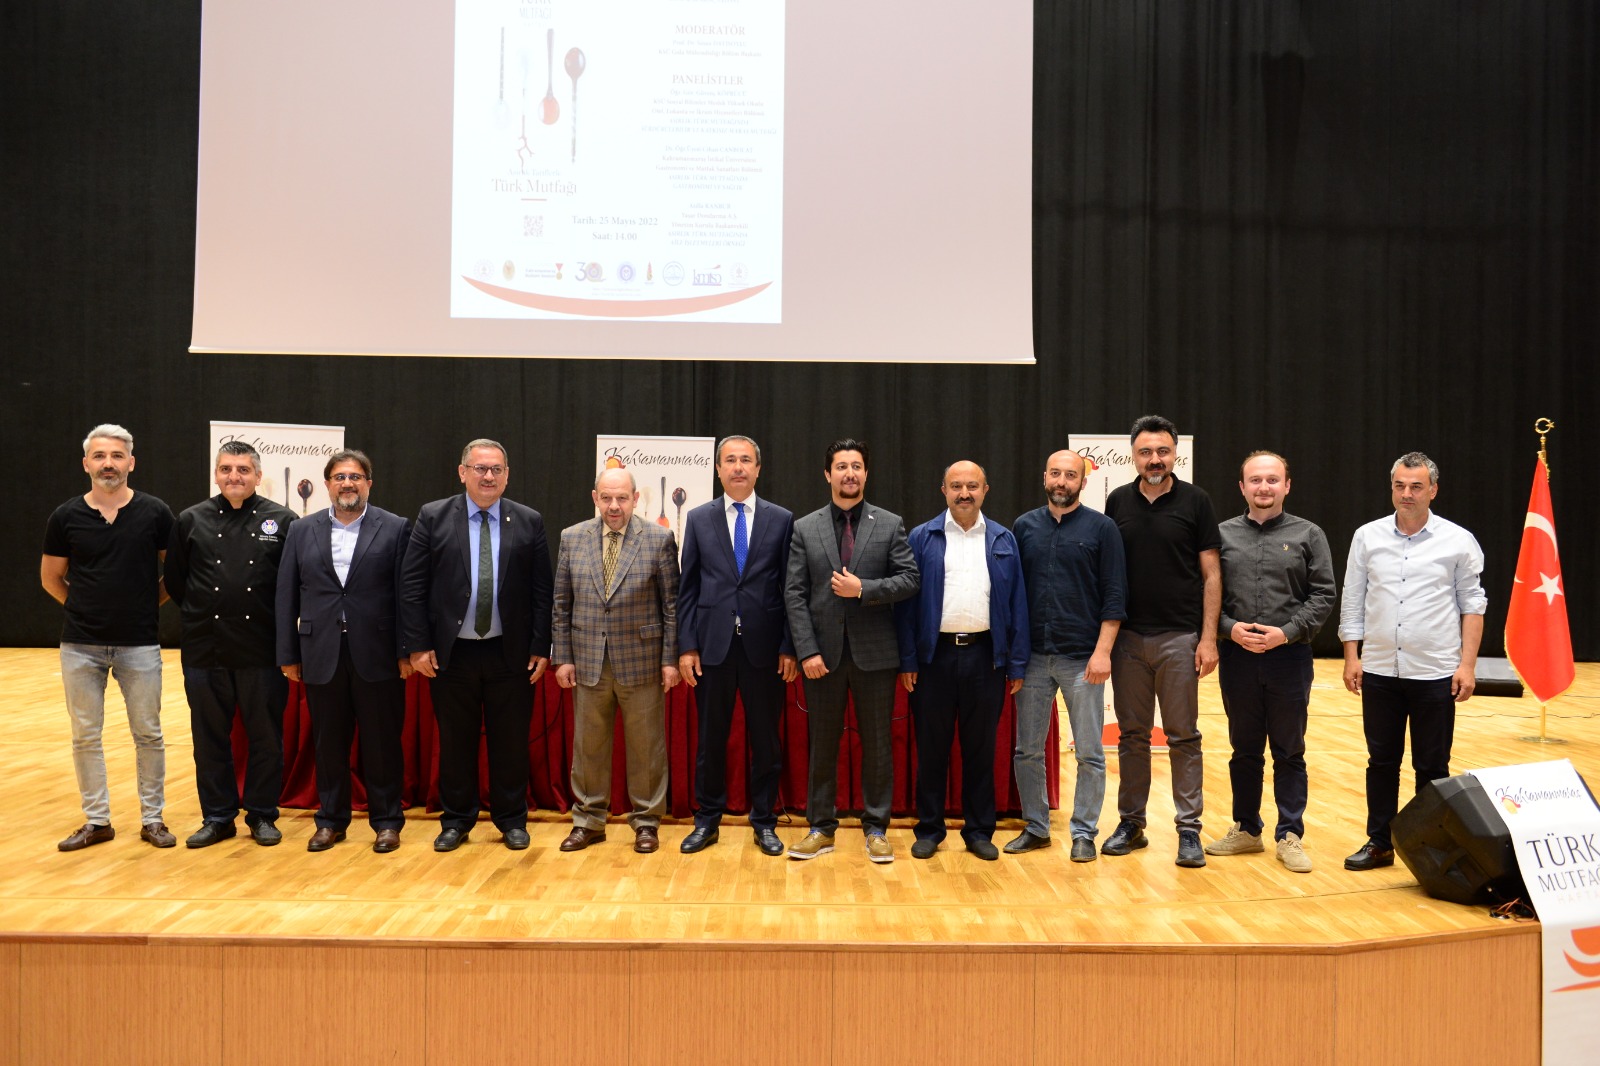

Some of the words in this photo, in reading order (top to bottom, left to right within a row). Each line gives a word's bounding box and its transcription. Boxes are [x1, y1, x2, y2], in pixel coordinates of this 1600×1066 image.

[674, 23, 746, 36] MODERATÖR
[672, 73, 744, 85] PANELİSTLER
[491, 178, 522, 192] Türk
[526, 178, 577, 196] Mutfağı
[571, 215, 597, 225] Tarih:
[599, 216, 609, 225] 25
[611, 216, 637, 227] Mayıs
[638, 217, 659, 226] 2022
[592, 232, 612, 240] Saat:
[615, 232, 638, 241] 14.00
[604, 446, 711, 468] Kahramanmaraş
[1526, 832, 1600, 869] TÜRK
